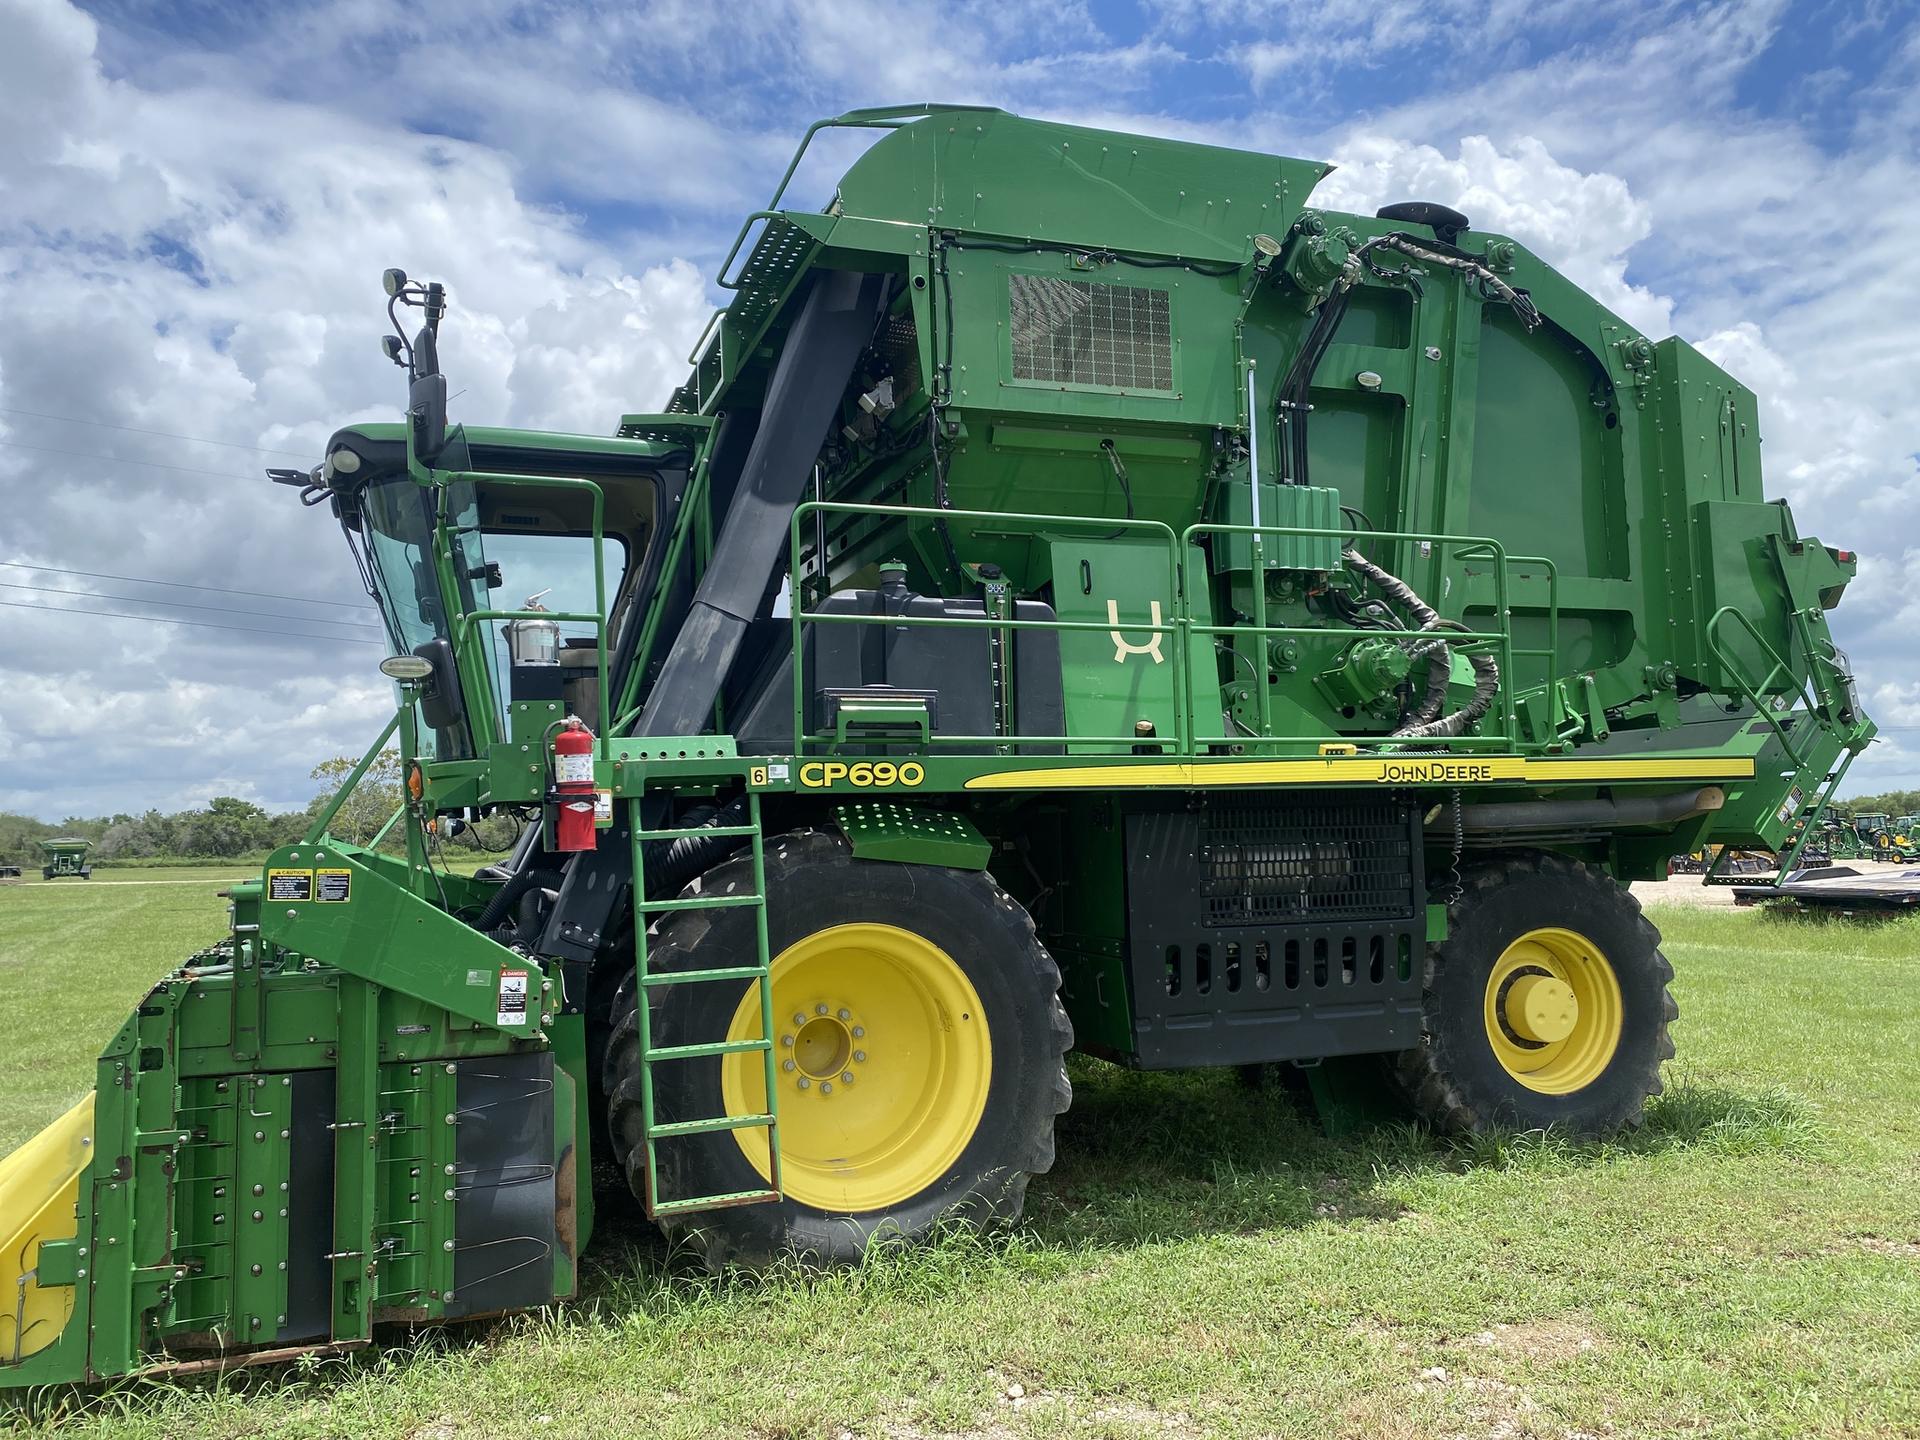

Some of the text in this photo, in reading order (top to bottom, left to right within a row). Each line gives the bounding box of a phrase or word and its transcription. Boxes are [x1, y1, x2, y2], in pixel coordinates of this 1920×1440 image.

[754, 769, 764, 783] 6
[799, 761, 925, 788] CP690
[1377, 762, 1492, 781] JOHN DEERE
